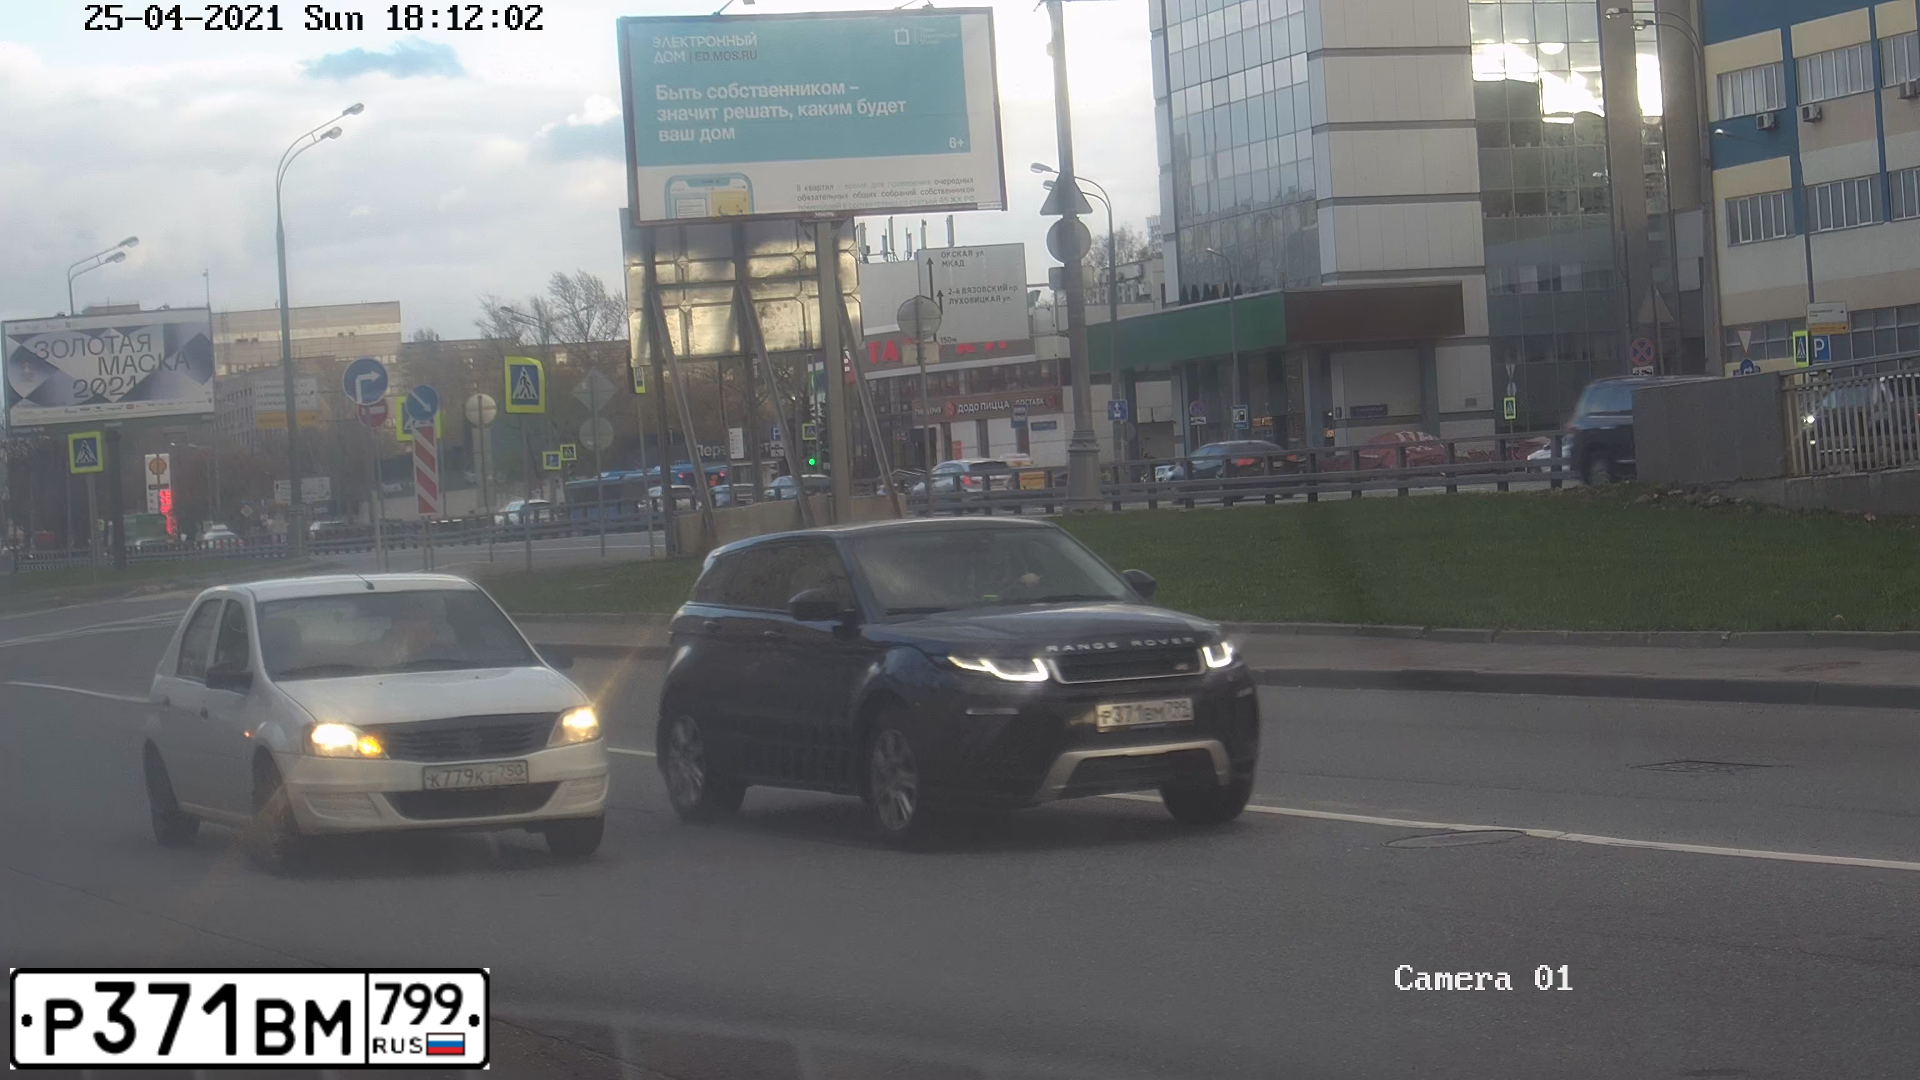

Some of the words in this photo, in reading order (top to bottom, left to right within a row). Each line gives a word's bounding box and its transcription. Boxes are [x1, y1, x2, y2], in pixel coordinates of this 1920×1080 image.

[653, 31, 758, 49] ЭЛЕКТРОННЫЙ
[654, 50, 687, 65] ДОМ
[694, 50, 758, 62] ED.MOS.RU
[655, 83, 703, 101] Быть
[707, 82, 845, 100] собственником
[657, 106, 718, 122] значит
[723, 104, 793, 123] решать,
[798, 101, 853, 117] каким
[857, 98, 906, 118] будет
[658, 128, 695, 143] ваш
[700, 127, 736, 144] дом
[949, 136, 964, 149] 6+
[804, 183, 834, 193] квартал
[933, 176, 974, 187] очередных
[797, 192, 849, 202] обязательных
[852, 190, 877, 201] общих
[880, 188, 917, 199] собраний
[920, 185, 975, 196] собственников
[940, 250, 973, 258] ОКСКАЯ
[961, 284, 1008, 294] ВЯЗОВСКИЙ
[948, 295, 1001, 305] ЛУХОВИЦКАЯ
[34, 333, 152, 360] ЗОЛОТАЯ
[98, 352, 190, 377] МАСКА
[73, 375, 138, 399] 2021
[980, 400, 1010, 411] ПИЦЦА
[1046, 641, 1119, 652] RANGE
[1130, 636, 1195, 647] ROVER
